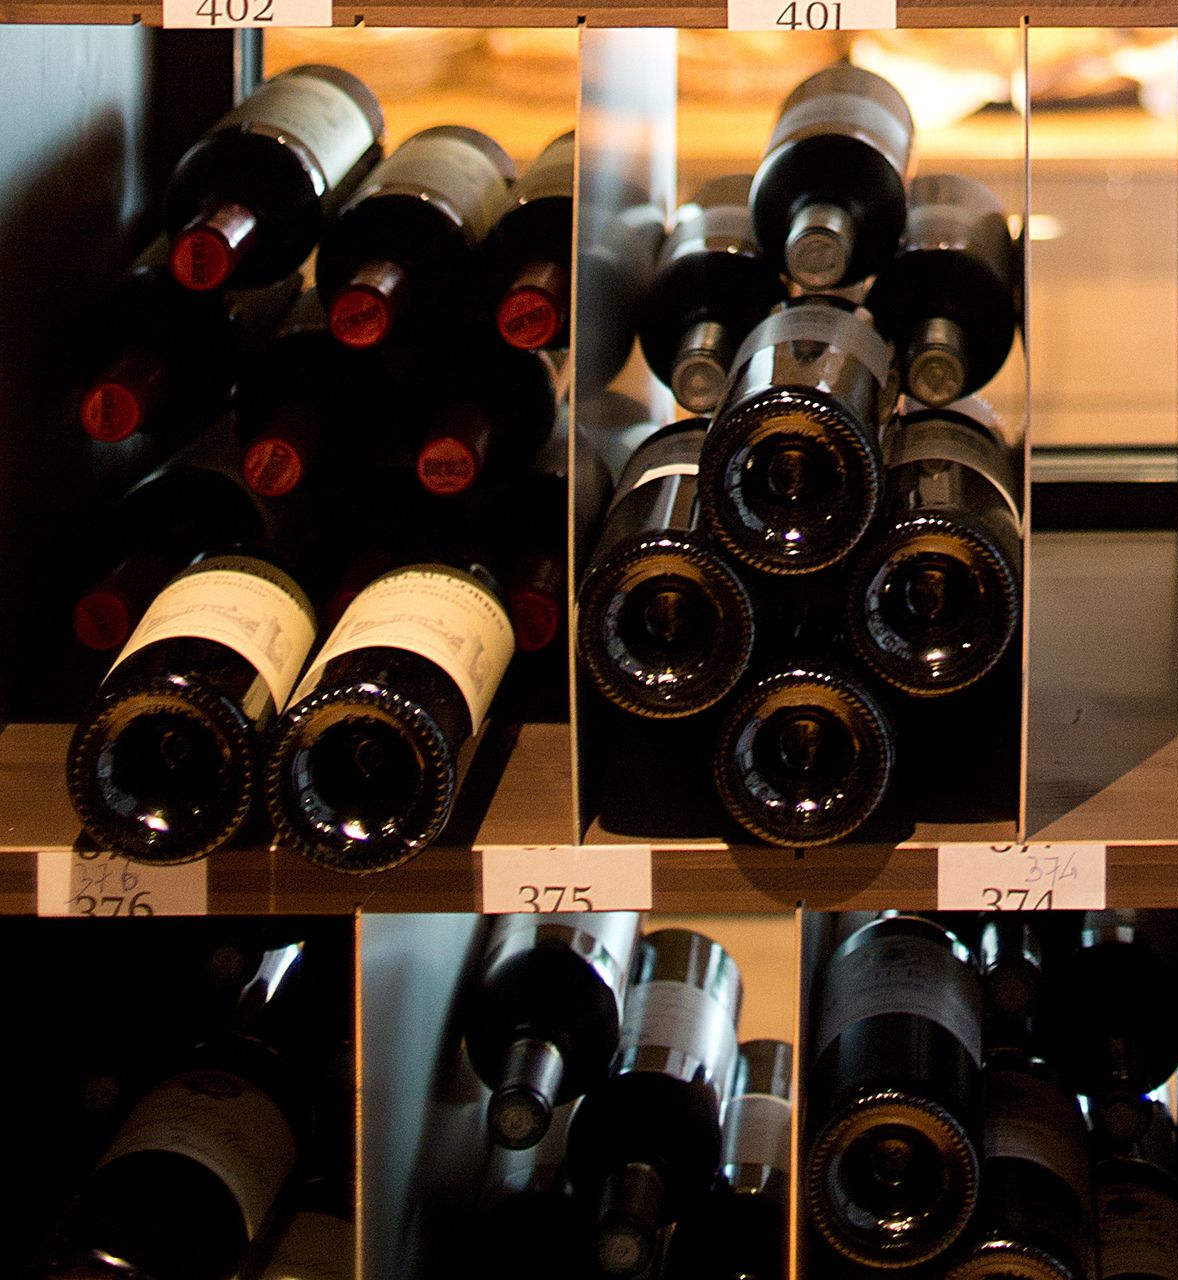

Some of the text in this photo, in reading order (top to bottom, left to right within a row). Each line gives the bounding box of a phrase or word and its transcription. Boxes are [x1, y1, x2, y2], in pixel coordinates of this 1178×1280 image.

[775, 0, 844, 30] 401
[75, 891, 153, 917] 376
[517, 885, 595, 912] 375
